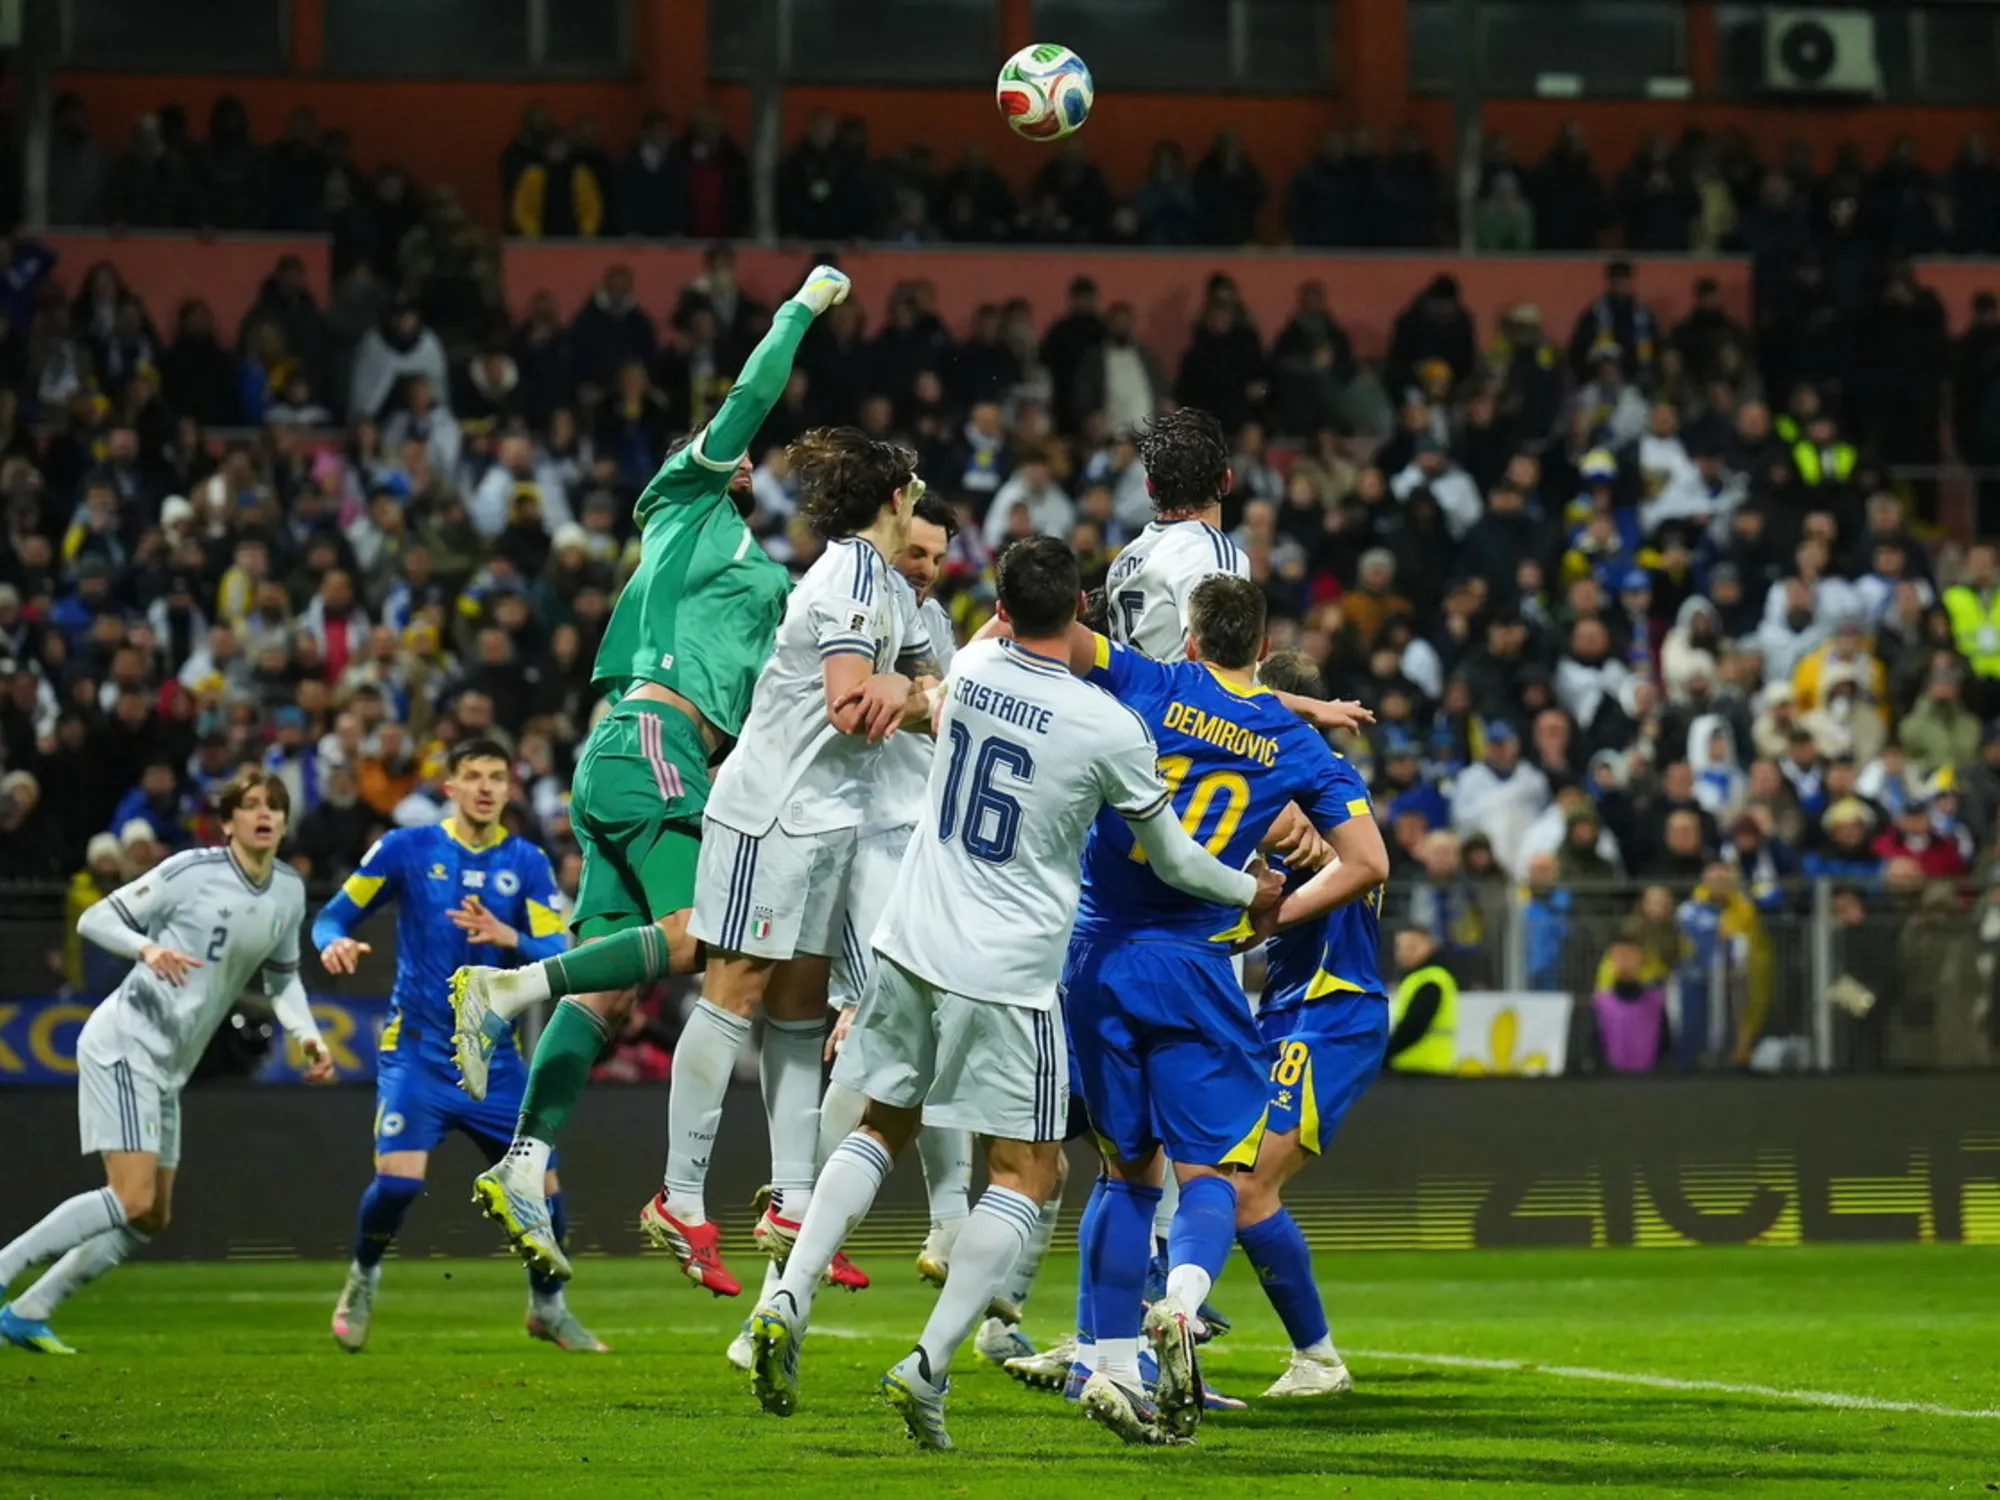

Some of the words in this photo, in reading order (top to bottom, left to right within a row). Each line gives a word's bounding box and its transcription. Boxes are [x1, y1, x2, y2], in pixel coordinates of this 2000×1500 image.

[954, 676, 1054, 735] CRISTANTE
[1162, 702, 1279, 767] DEMIROVIĆ
[939, 718, 1036, 866] 16
[1128, 754, 1250, 864] 10
[207, 926, 228, 962] 2
